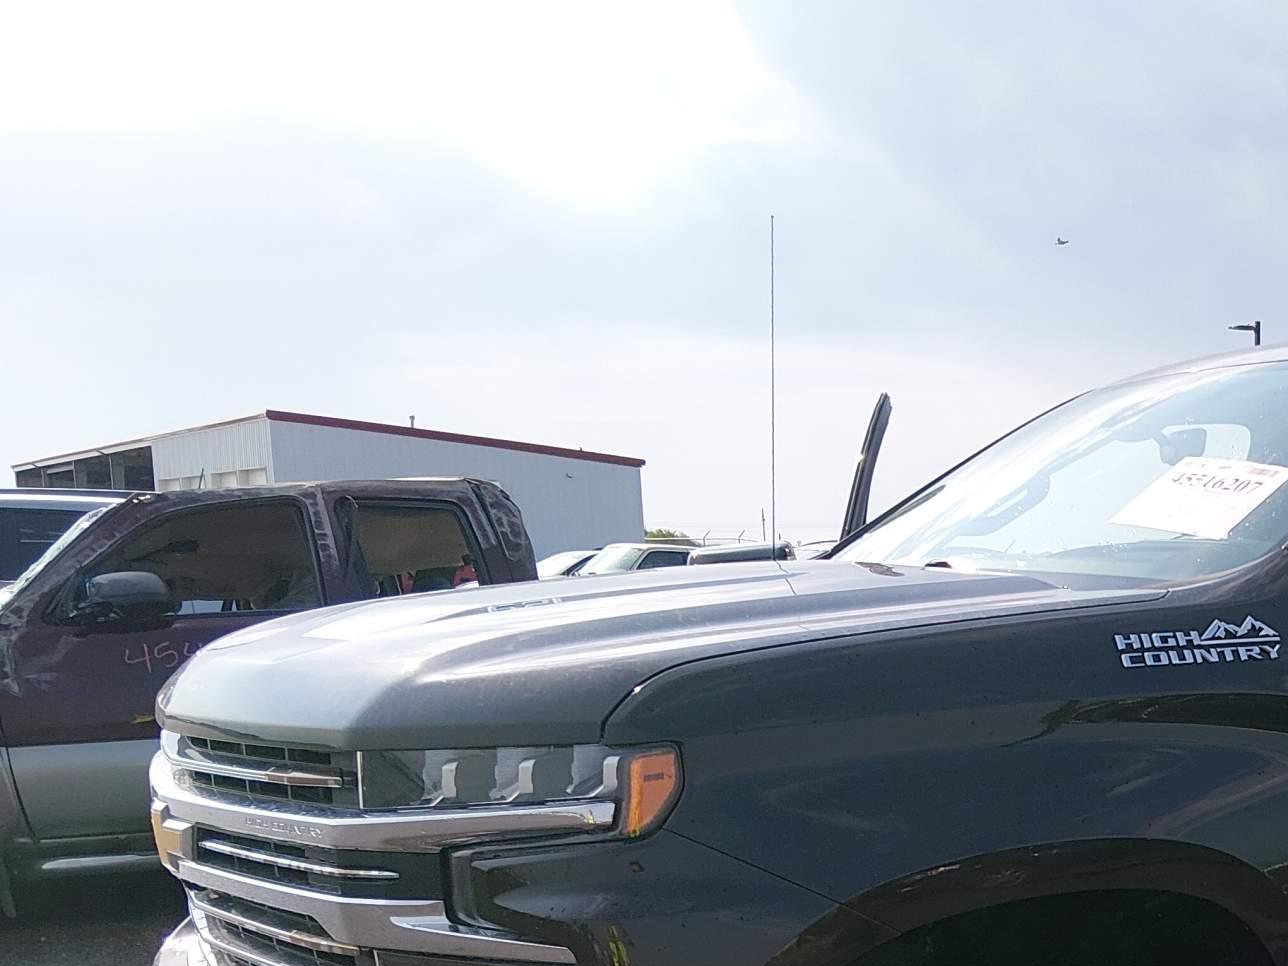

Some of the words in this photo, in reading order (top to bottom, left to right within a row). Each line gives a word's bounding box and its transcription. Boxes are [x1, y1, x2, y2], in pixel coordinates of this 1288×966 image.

[1171, 472, 1264, 494] 45516207
[1114, 631, 1201, 650] HIGH
[1120, 644, 1281, 668] COUNTRY
